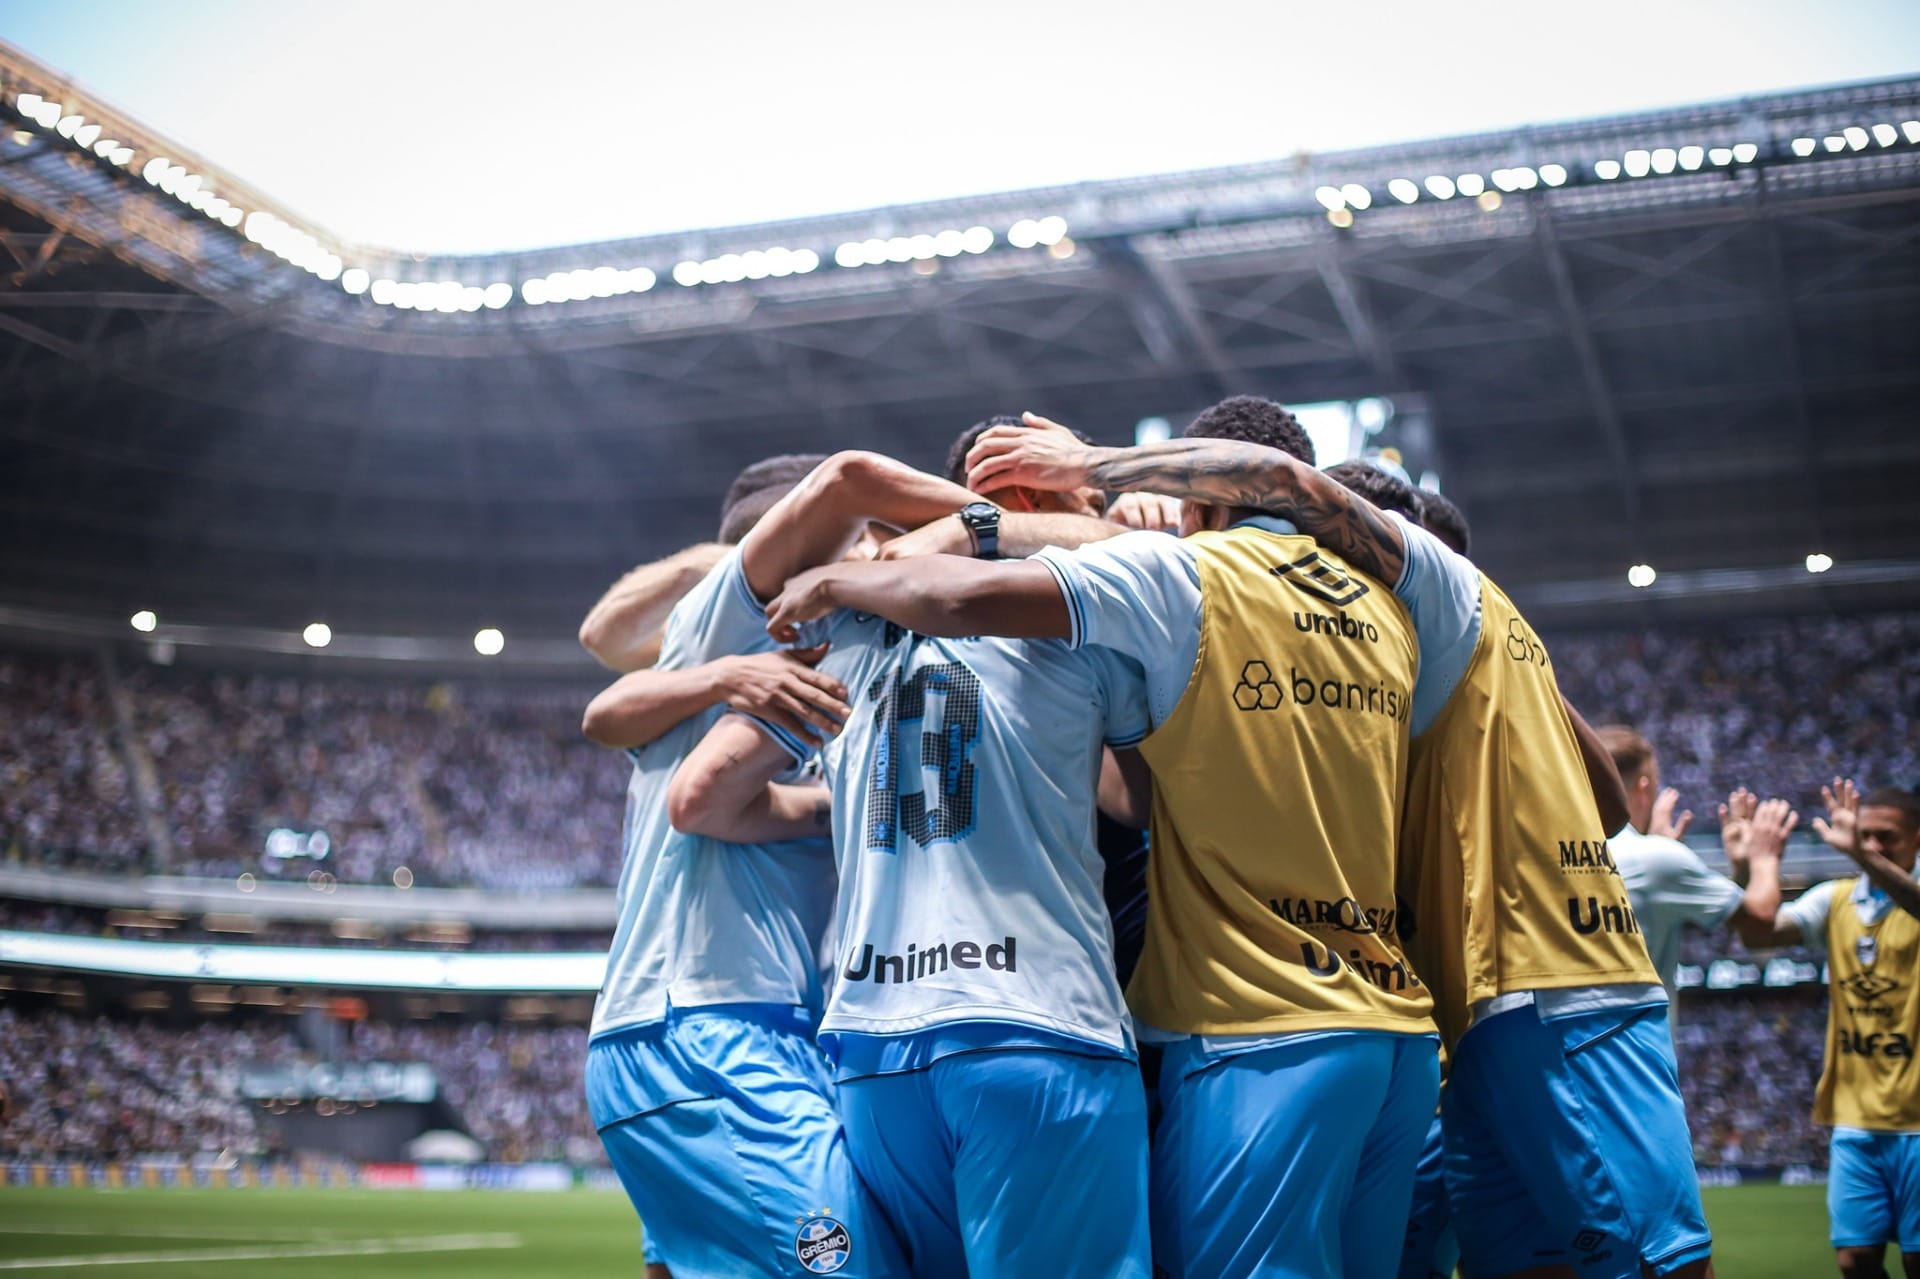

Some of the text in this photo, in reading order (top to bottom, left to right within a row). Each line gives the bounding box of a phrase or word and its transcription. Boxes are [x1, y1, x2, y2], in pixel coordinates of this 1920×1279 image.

[1294, 611, 1378, 643] umbro
[868, 661, 982, 854] 13
[1568, 896, 1639, 934] Uni
[844, 936, 1016, 984] Unimed
